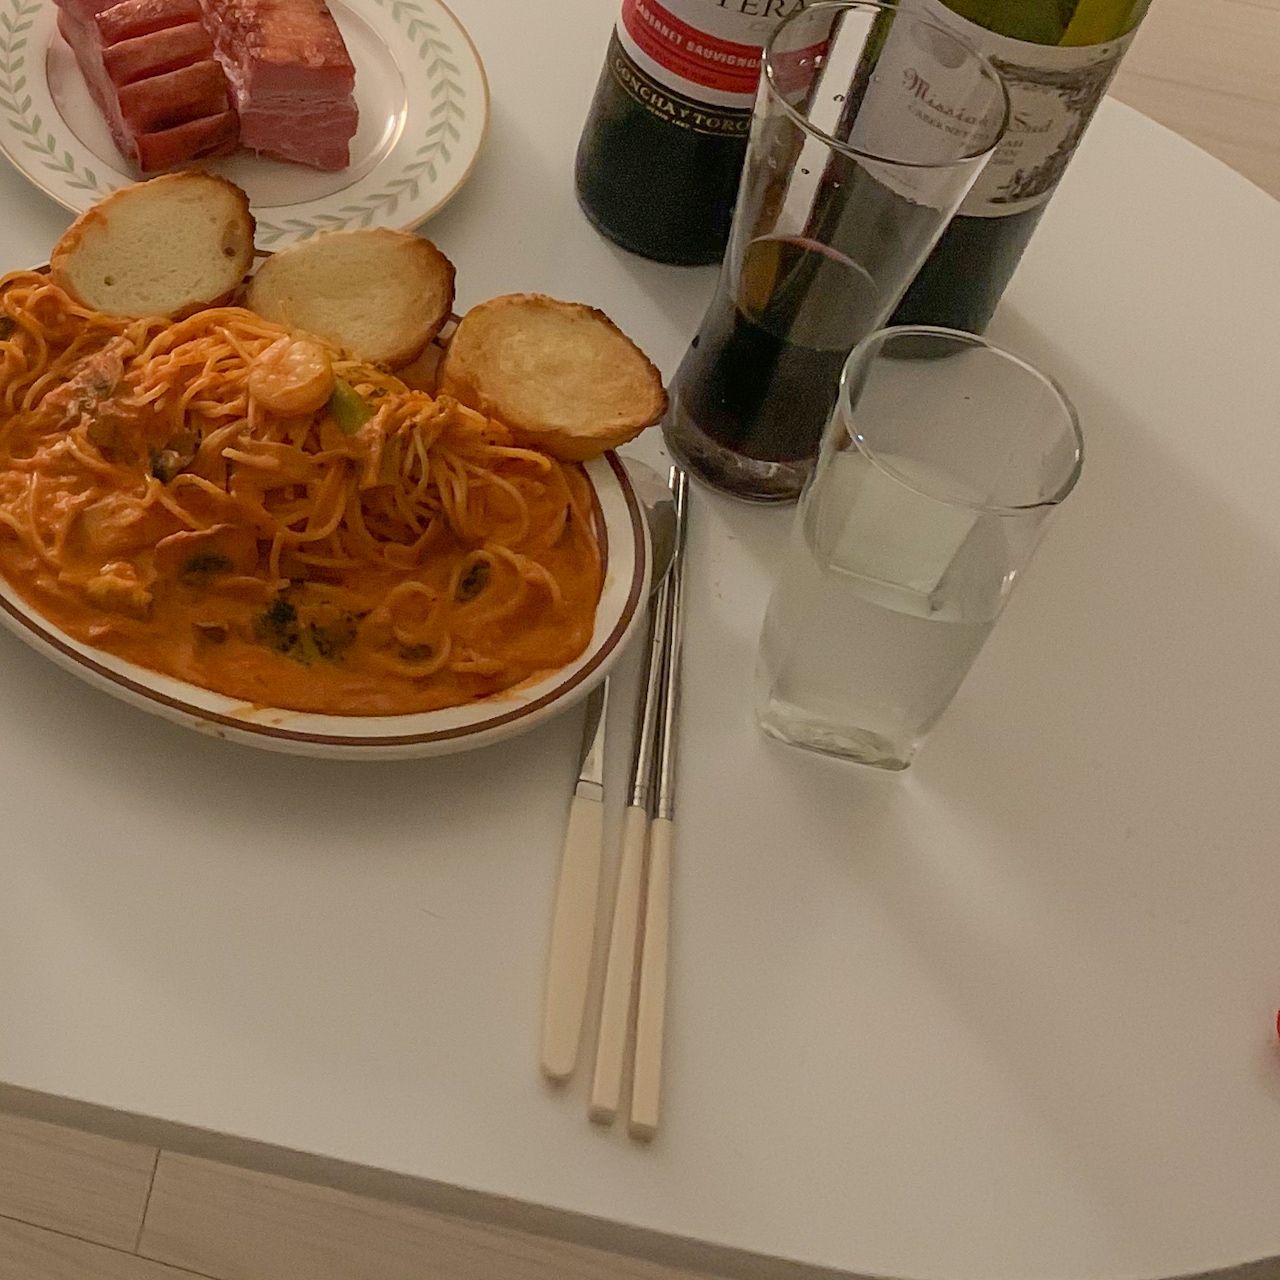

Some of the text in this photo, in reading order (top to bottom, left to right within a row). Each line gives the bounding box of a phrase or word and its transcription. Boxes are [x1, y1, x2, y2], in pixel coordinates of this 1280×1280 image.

[686, 41, 762, 69] SAUVIGNO
[615, 58, 677, 115] CONCHA
[691, 112, 752, 131] TORO
